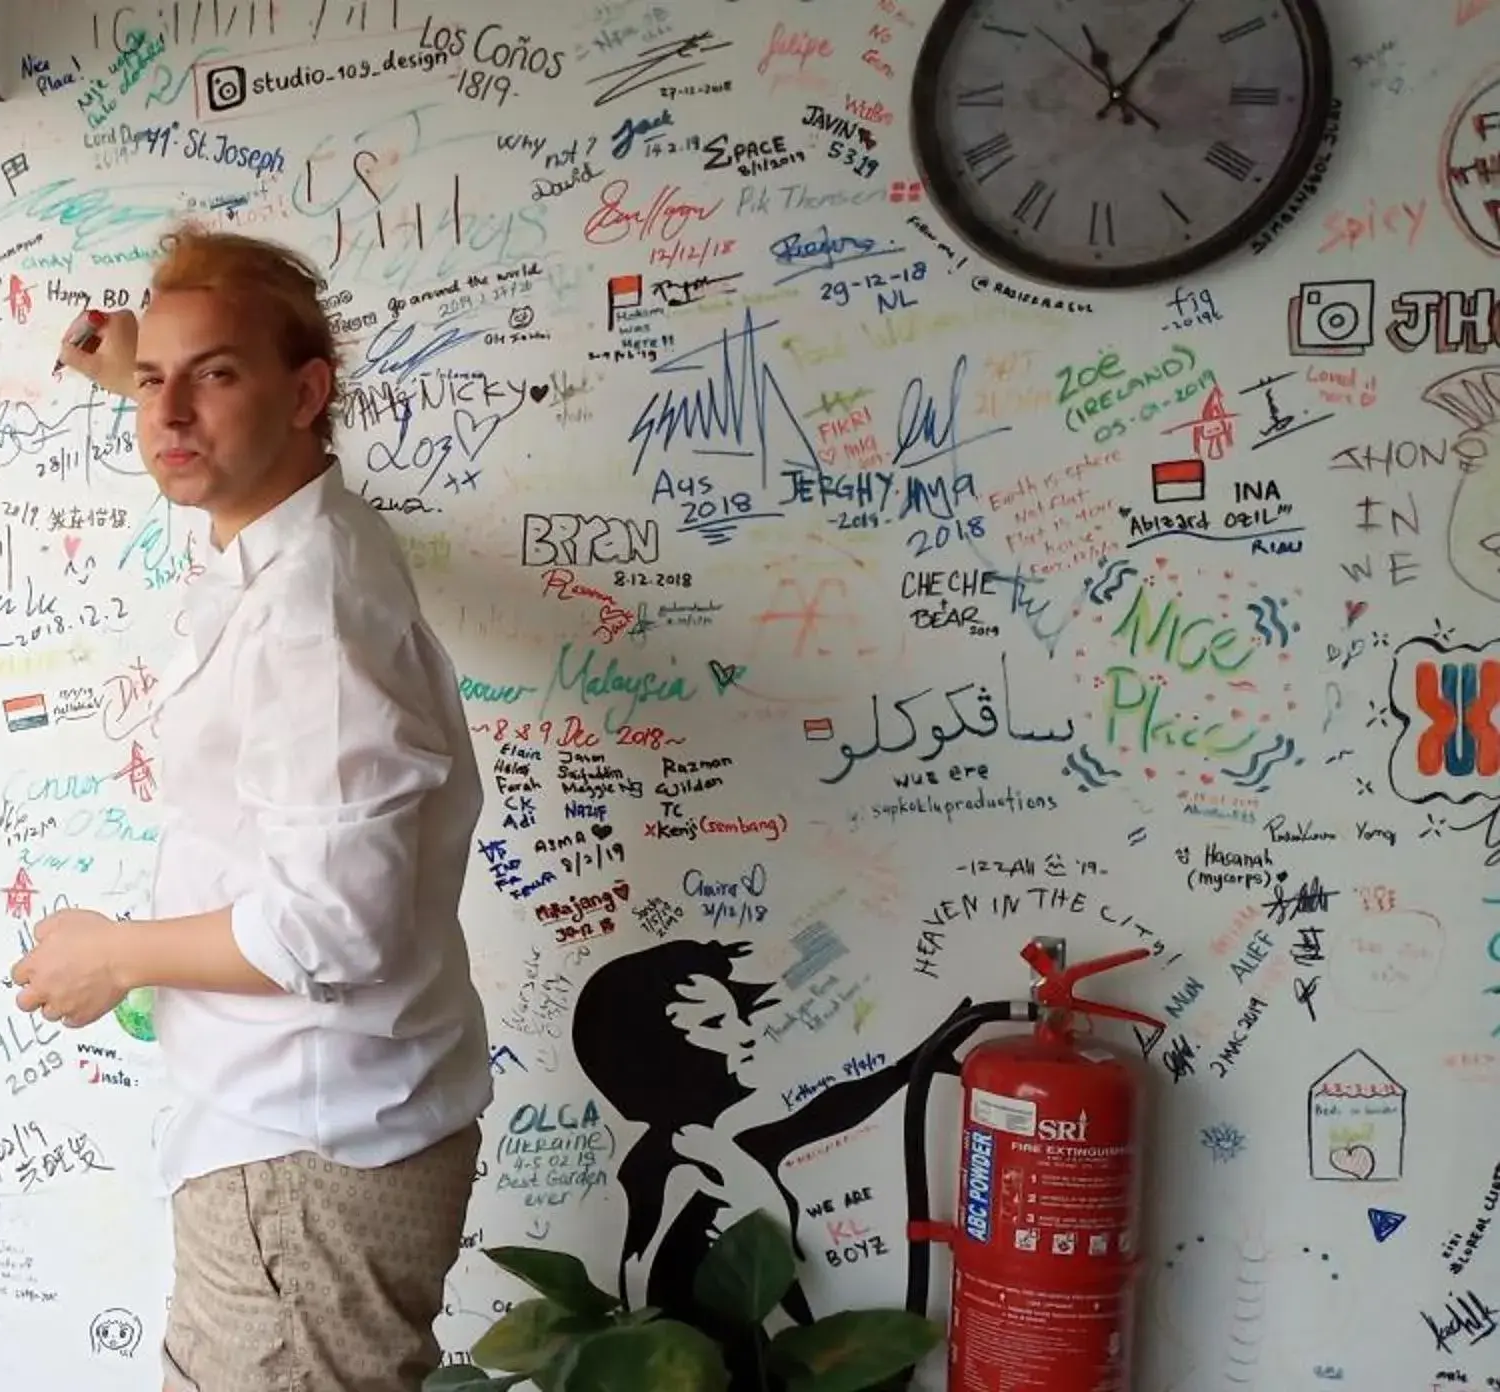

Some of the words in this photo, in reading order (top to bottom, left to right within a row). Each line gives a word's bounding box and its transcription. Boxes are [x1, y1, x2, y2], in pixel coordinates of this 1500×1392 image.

[802, 104, 861, 141] JAVIN
[213, 134, 285, 174] Joseph
[820, 260, 928, 306] 29-12-18
[877, 290, 918, 315] NL
[1234, 480, 1281, 501] INA
[682, 494, 754, 524] 2018
[908, 605, 984, 630] BEAR
[556, 716, 600, 748] Dec
[504, 796, 537, 812] CK
[659, 801, 684, 818] TC
[502, 811, 537, 831] Adi
[913, 893, 979, 979] HEAVEN
[992, 896, 1020, 918] IN
[1027, 887, 1087, 913] THE
[4, 1052, 66, 1096] 2019
[1037, 1109, 1089, 1142] SRI
[1011, 1141, 1042, 1153] FIRE
[968, 1130, 994, 1203] POWDER
[806, 1200, 835, 1218] WE
[842, 1187, 873, 1207] ARE
[966, 1205, 988, 1243] ABC
[824, 1235, 891, 1268] BOYZ
